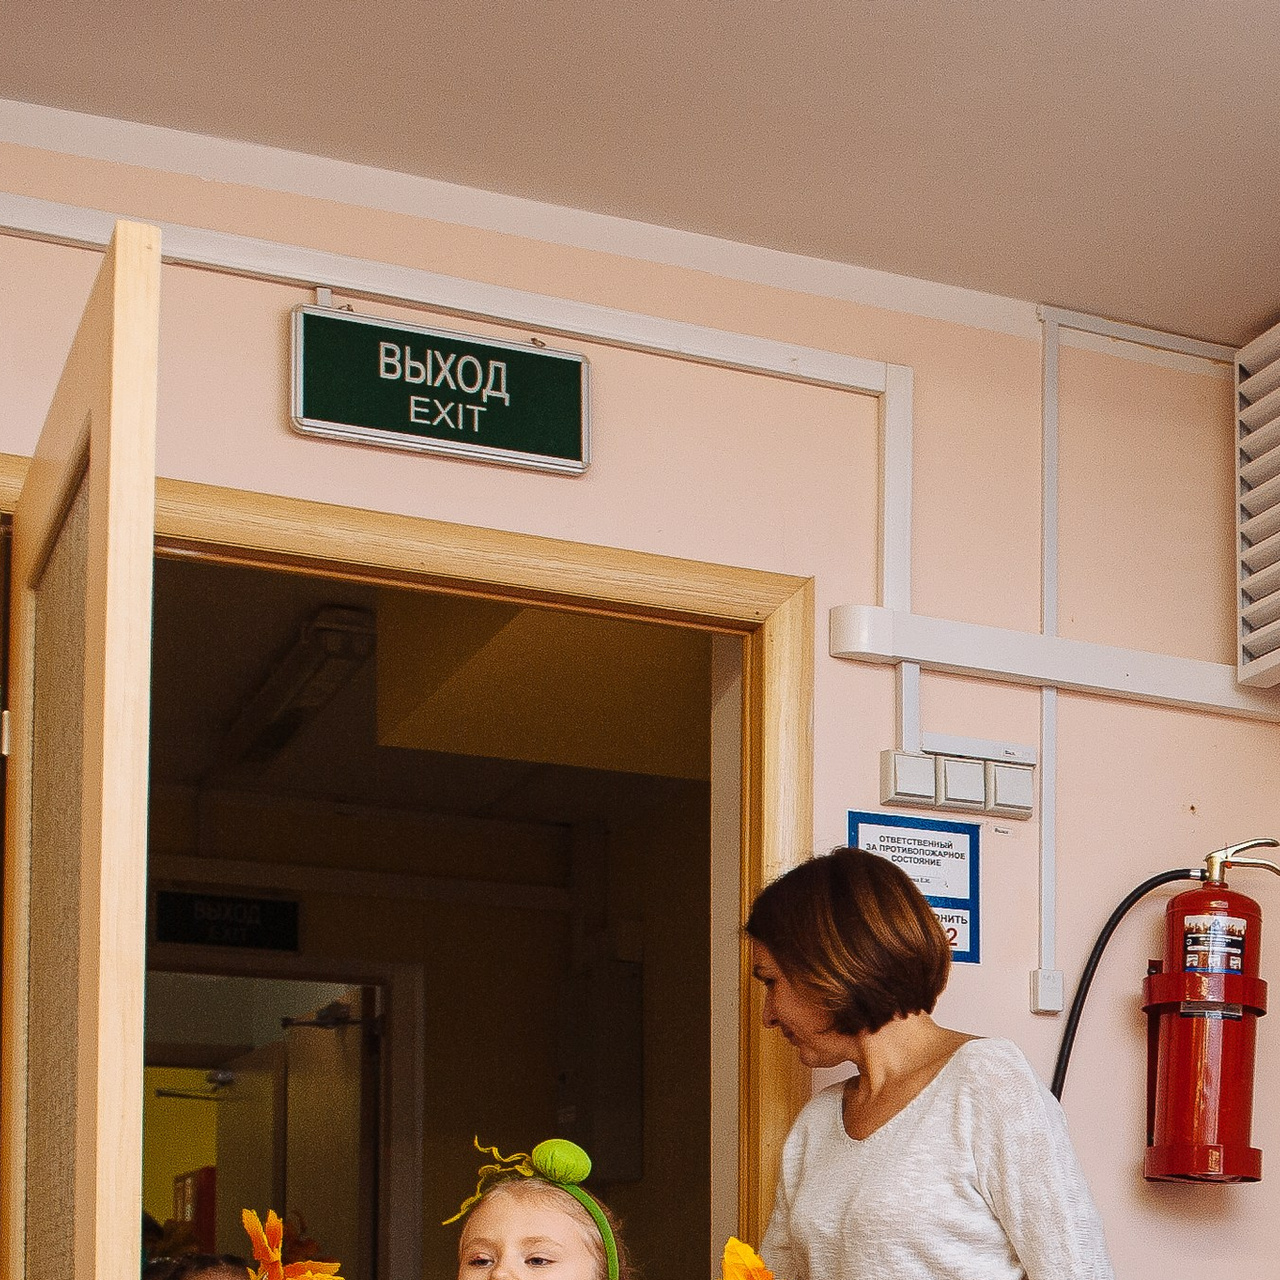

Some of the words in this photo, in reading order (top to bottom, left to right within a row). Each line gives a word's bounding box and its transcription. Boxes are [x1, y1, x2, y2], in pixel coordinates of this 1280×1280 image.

[379, 341, 510, 406] ВЫХОД
[410, 395, 487, 432] EXIT
[879, 835, 954, 849] ОТВЕТСТВЕННЫЙ
[866, 843, 878, 852] ЗА
[879, 845, 966, 860] ПРОТИВОПОЖАРНОЕ
[891, 855, 942, 867] СОСТОЯНИЕ
